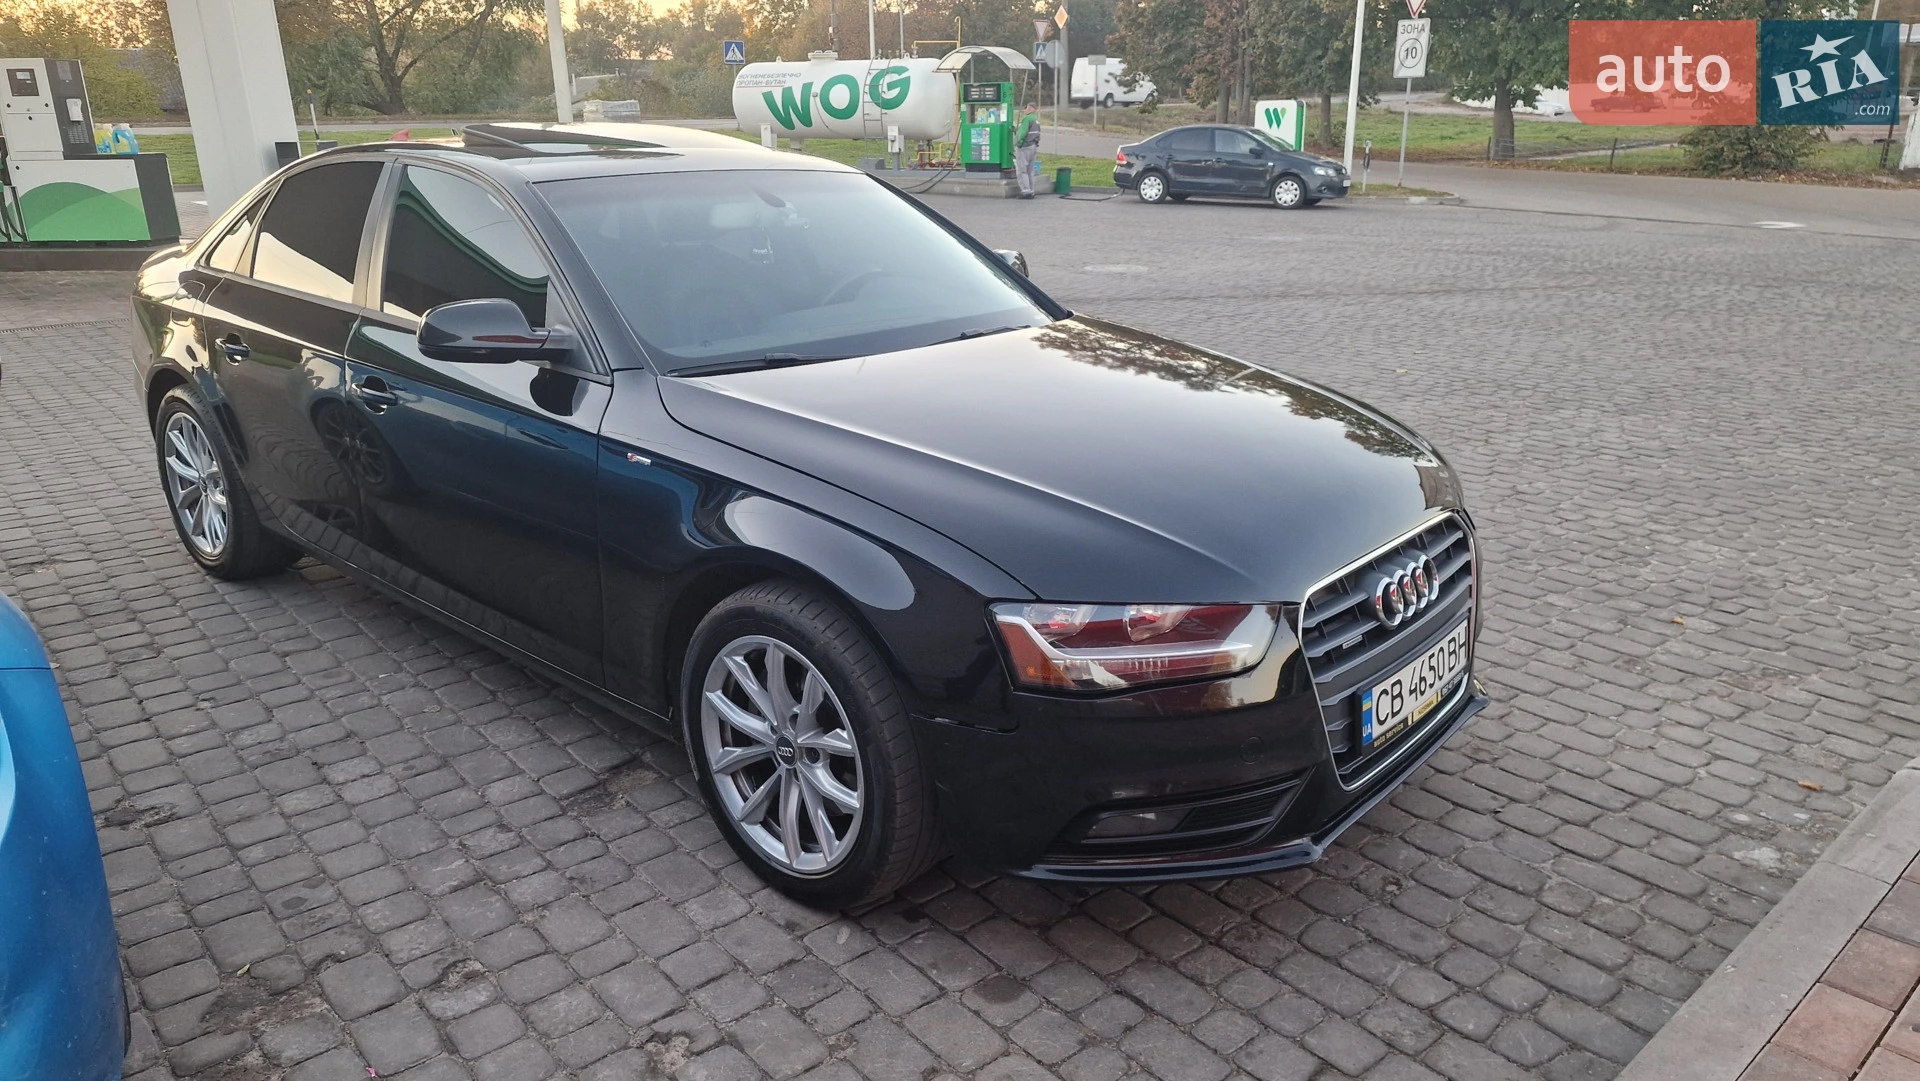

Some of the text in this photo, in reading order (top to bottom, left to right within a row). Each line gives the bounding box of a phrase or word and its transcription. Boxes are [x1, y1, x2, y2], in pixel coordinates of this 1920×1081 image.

[1400, 23, 1426, 35] ЗОНА
[1404, 46, 1418, 60] 10
[761, 65, 911, 131] WOG
[1375, 678, 1404, 726] CB
[1409, 646, 1445, 702] 4650
[1448, 625, 1468, 673] BH
[1363, 723, 1372, 737] UA
